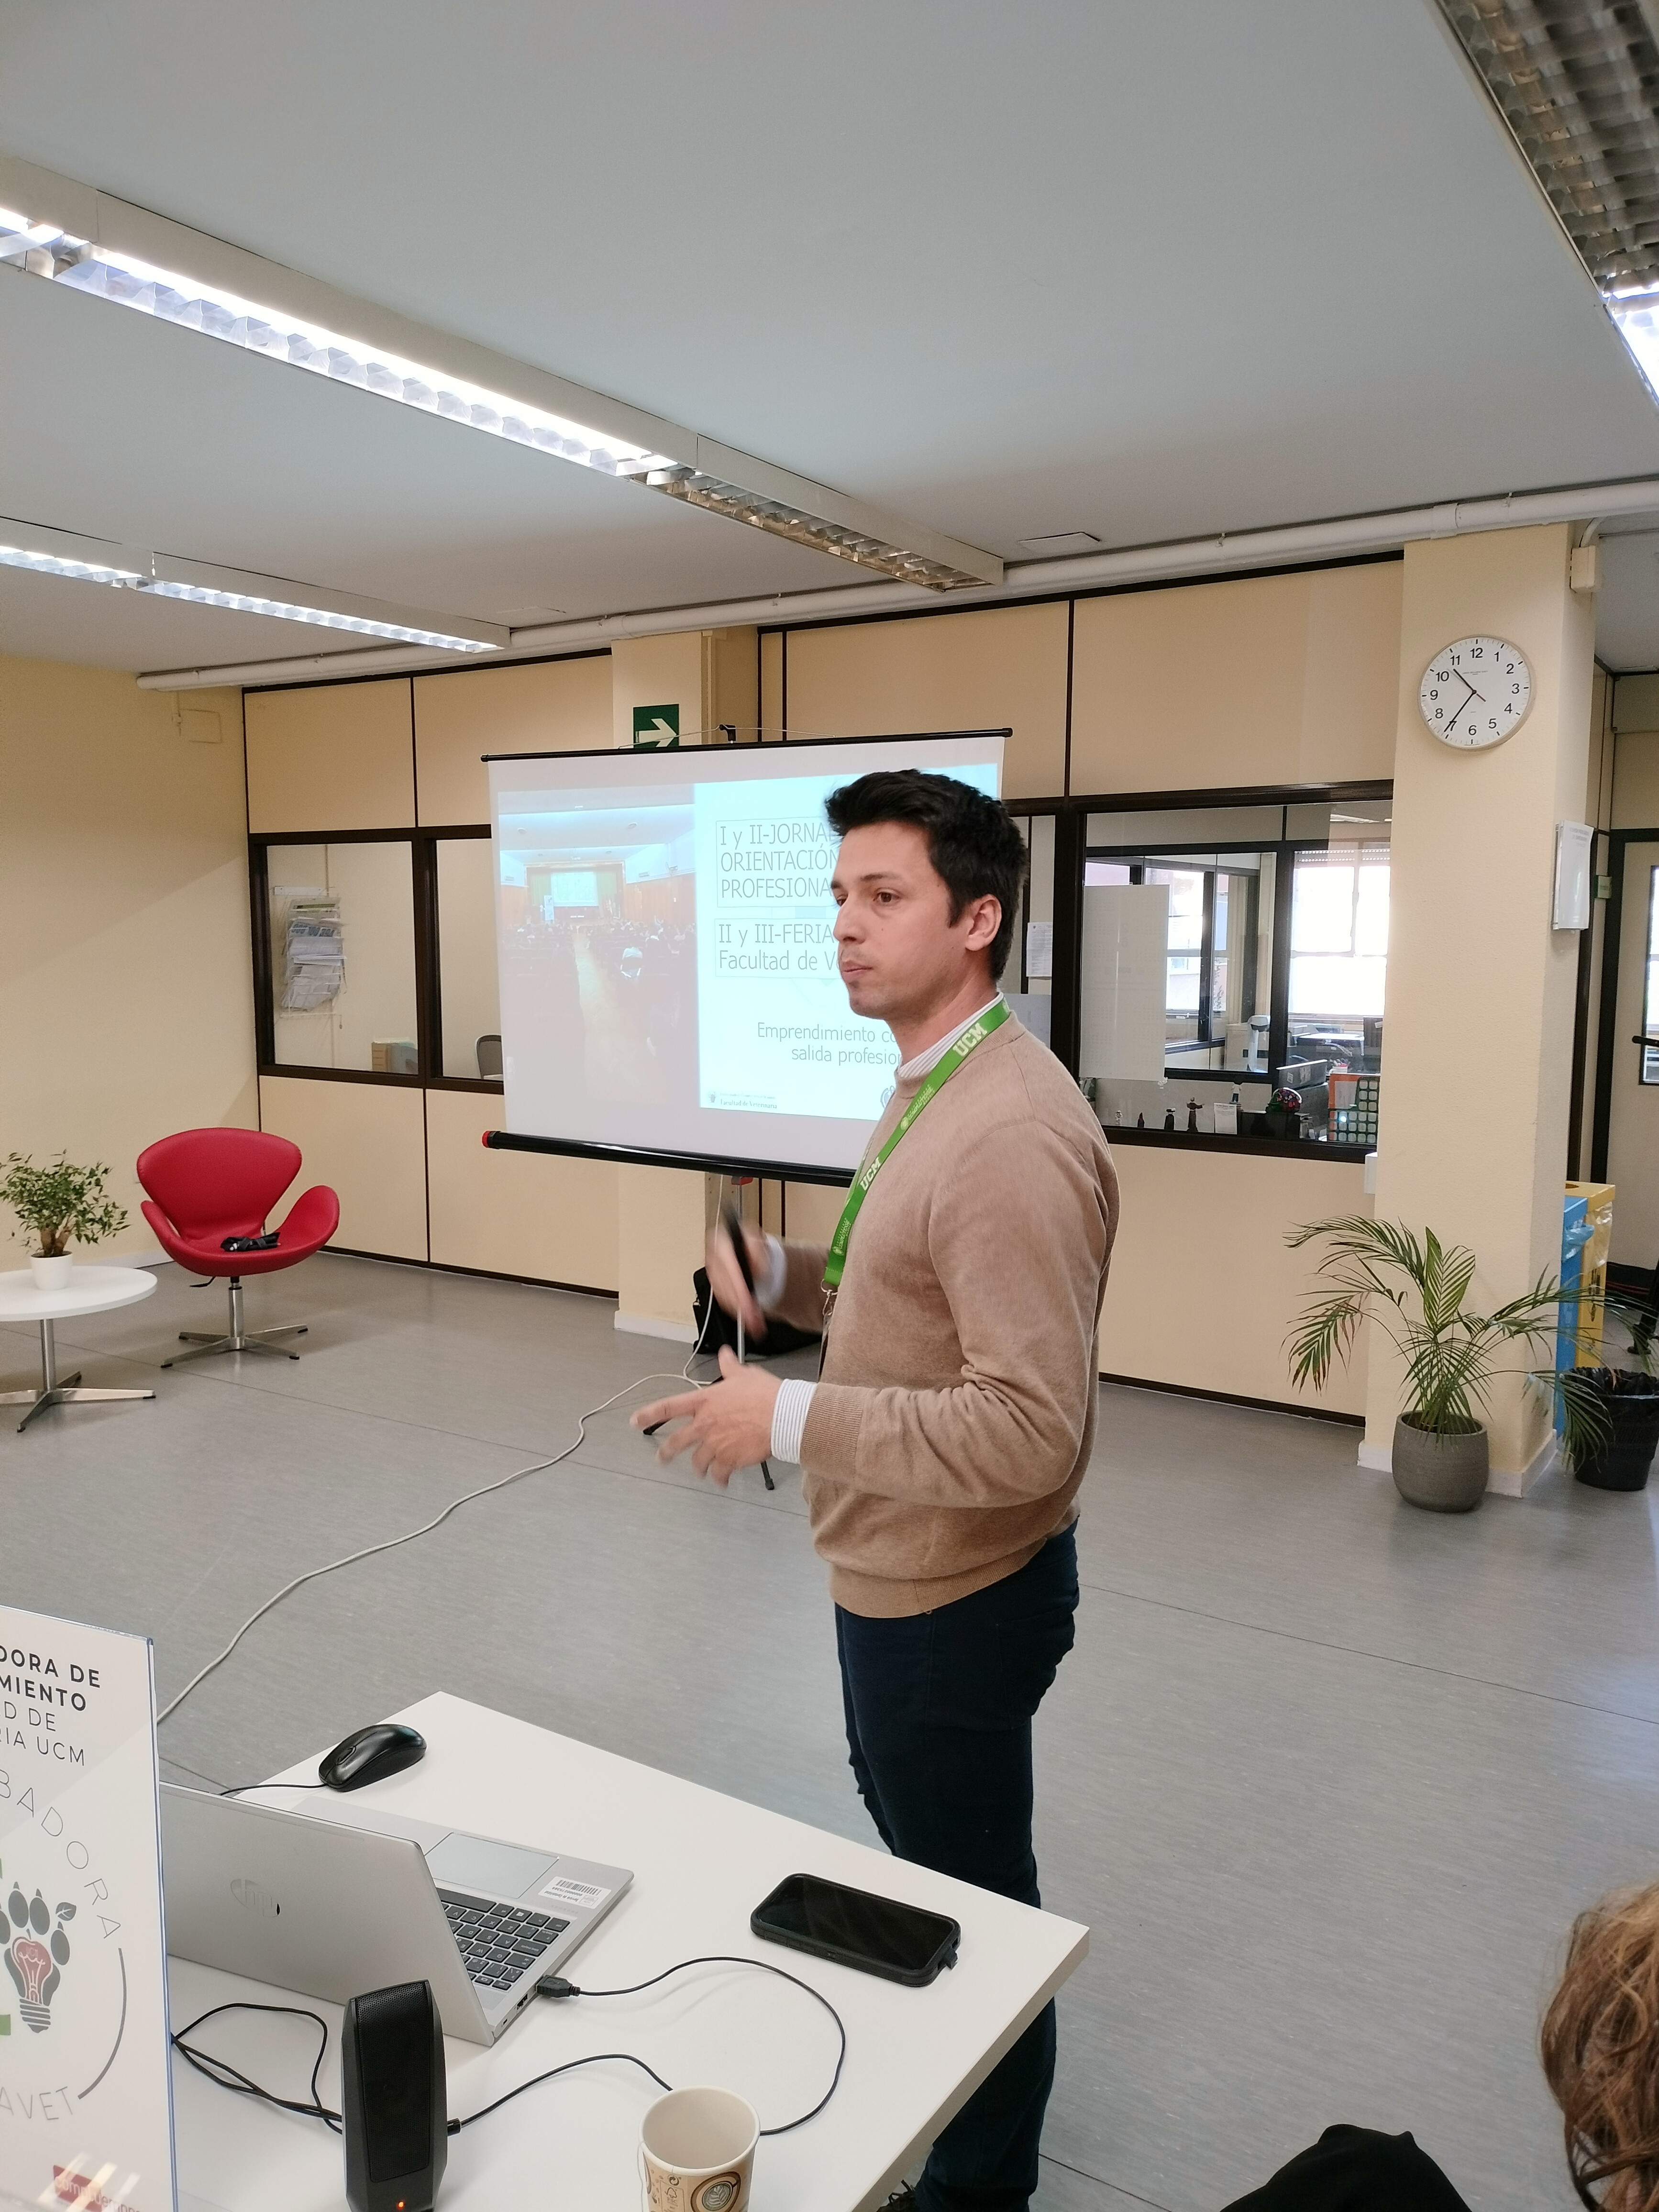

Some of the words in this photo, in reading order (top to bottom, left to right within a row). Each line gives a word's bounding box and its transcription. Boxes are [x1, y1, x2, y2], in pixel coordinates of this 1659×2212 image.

[1470, 647, 1483, 659] 12
[1494, 652, 1499, 662] 1
[1450, 655, 1460, 665] 11
[1506, 664, 1514, 674] 2
[1435, 671, 1449, 682] 10
[1511, 683, 1520, 694] 3
[1430, 690, 1438, 700] 9
[1435, 708, 1443, 719] 8
[1504, 703, 1513, 714] 4
[1449, 720, 1457, 731] 7
[1488, 719, 1496, 729] 5
[1468, 725, 1477, 736] 6
[733, 831, 742, 850] y
[719, 924, 731, 943] II
[738, 929, 748, 948] y
[755, 924, 834, 943] III-FERIA
[720, 950, 789, 970] Facultad
[798, 950, 818, 970] de
[824, 951, 839, 971] V
[758, 1022, 875, 1042] Emprendimiento
[952, 1023, 988, 1057] UCM
[792, 1044, 831, 1062] salida
[860, 1156, 881, 1191] UCM
[70, 1664, 100, 1689] DE
[29, 1706, 56, 1732] DE
[36, 1736, 85, 1766] UCM
